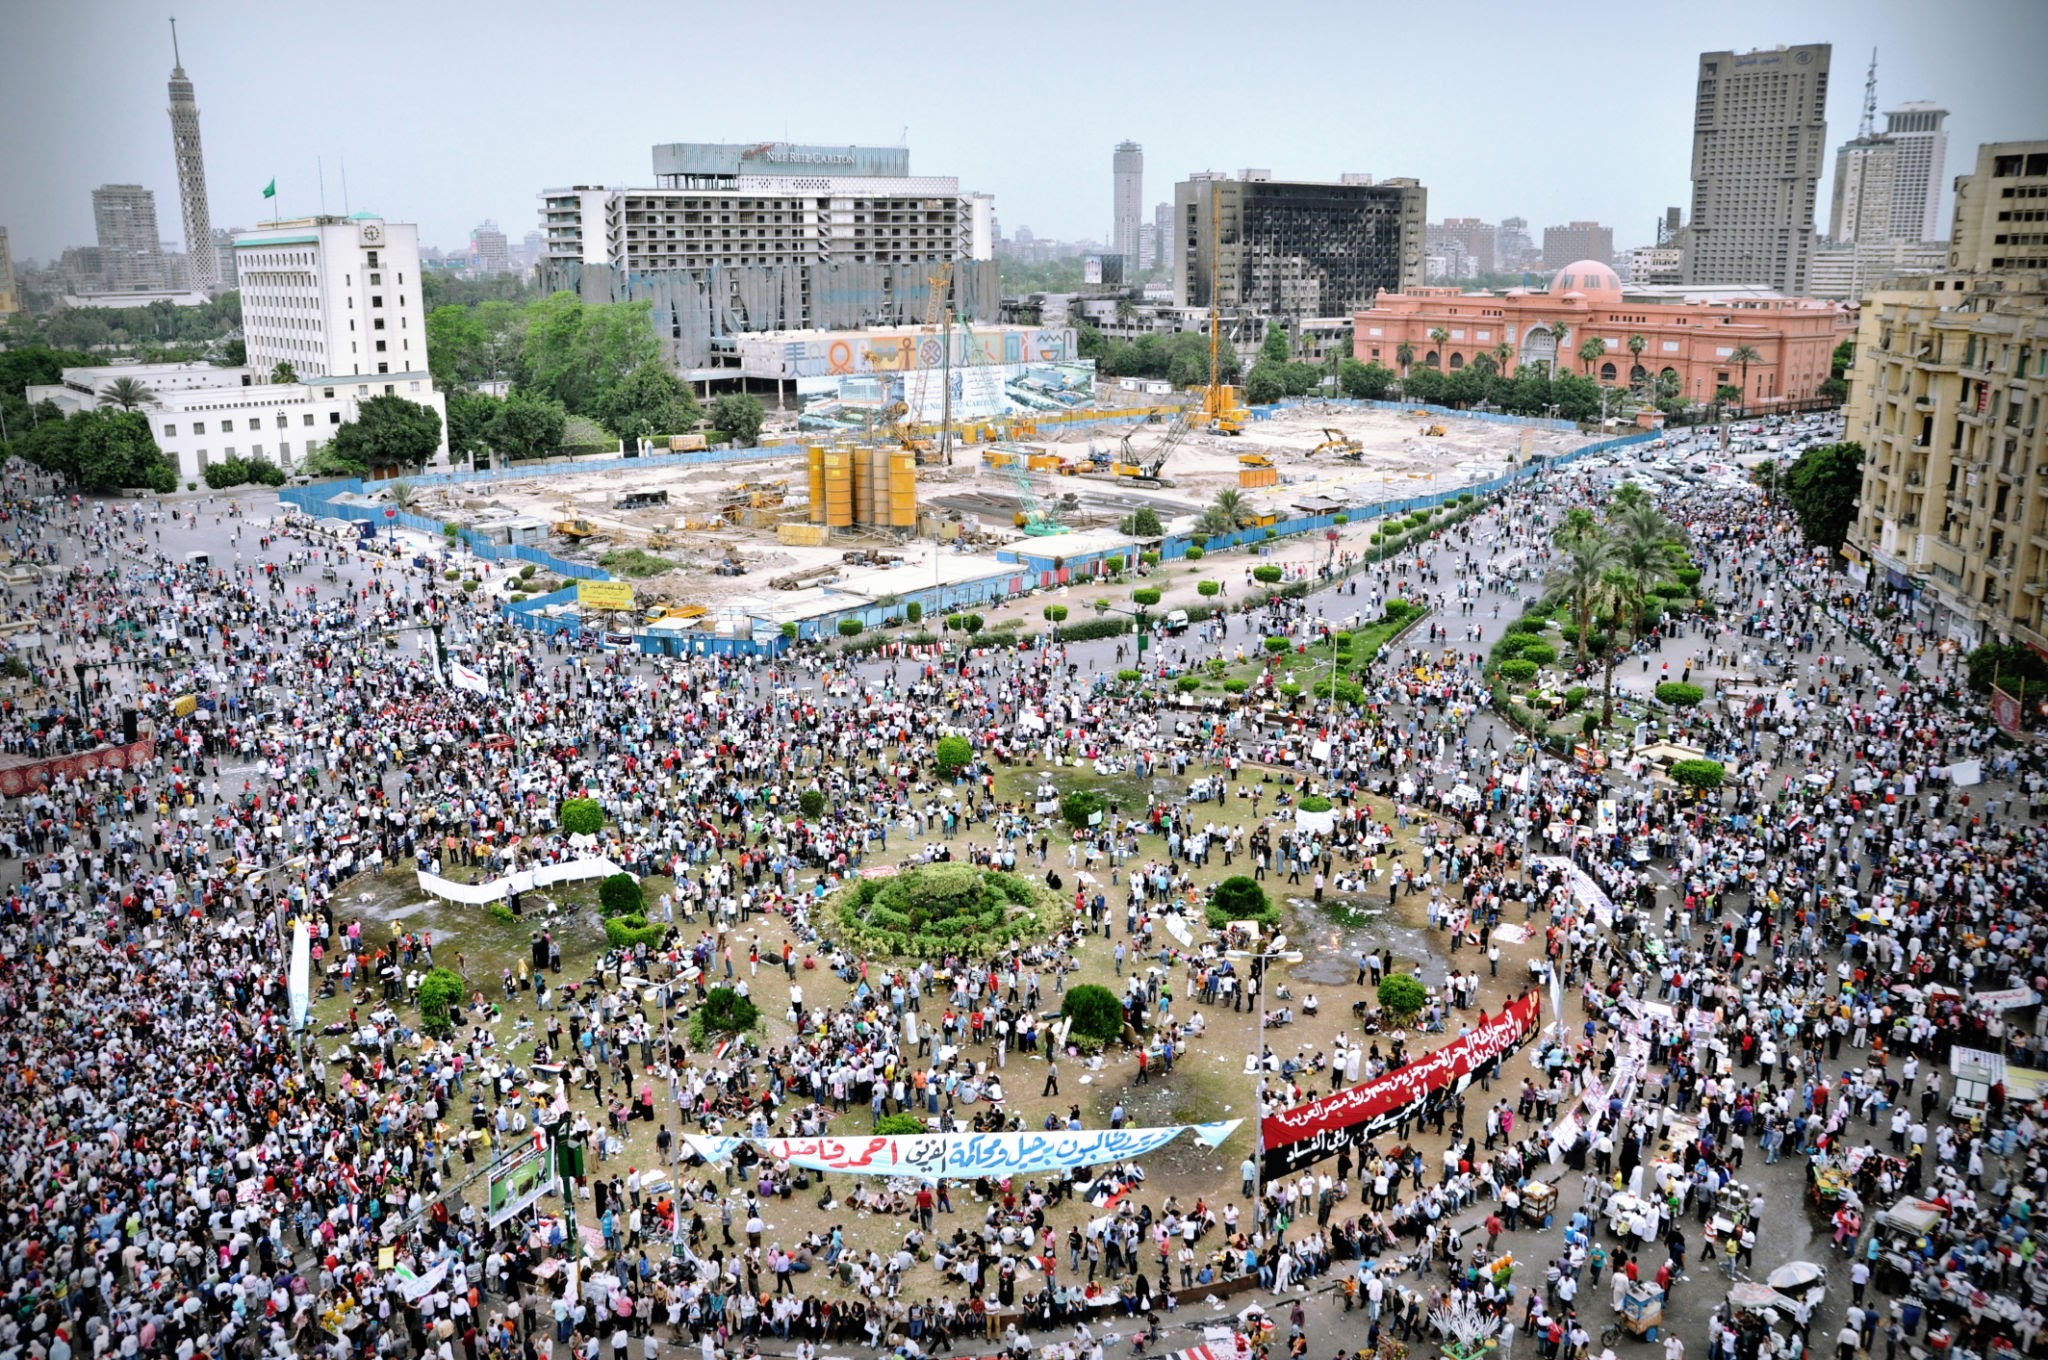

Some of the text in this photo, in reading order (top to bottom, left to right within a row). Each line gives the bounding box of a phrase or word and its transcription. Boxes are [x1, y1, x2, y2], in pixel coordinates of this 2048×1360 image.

[1276, 1102, 1323, 1127] العربية
[1318, 1098, 1348, 1121] مصر
[769, 1139, 846, 1161] فاضل
[829, 1137, 898, 1168] احمد
[905, 1138, 947, 1174] الفريق
